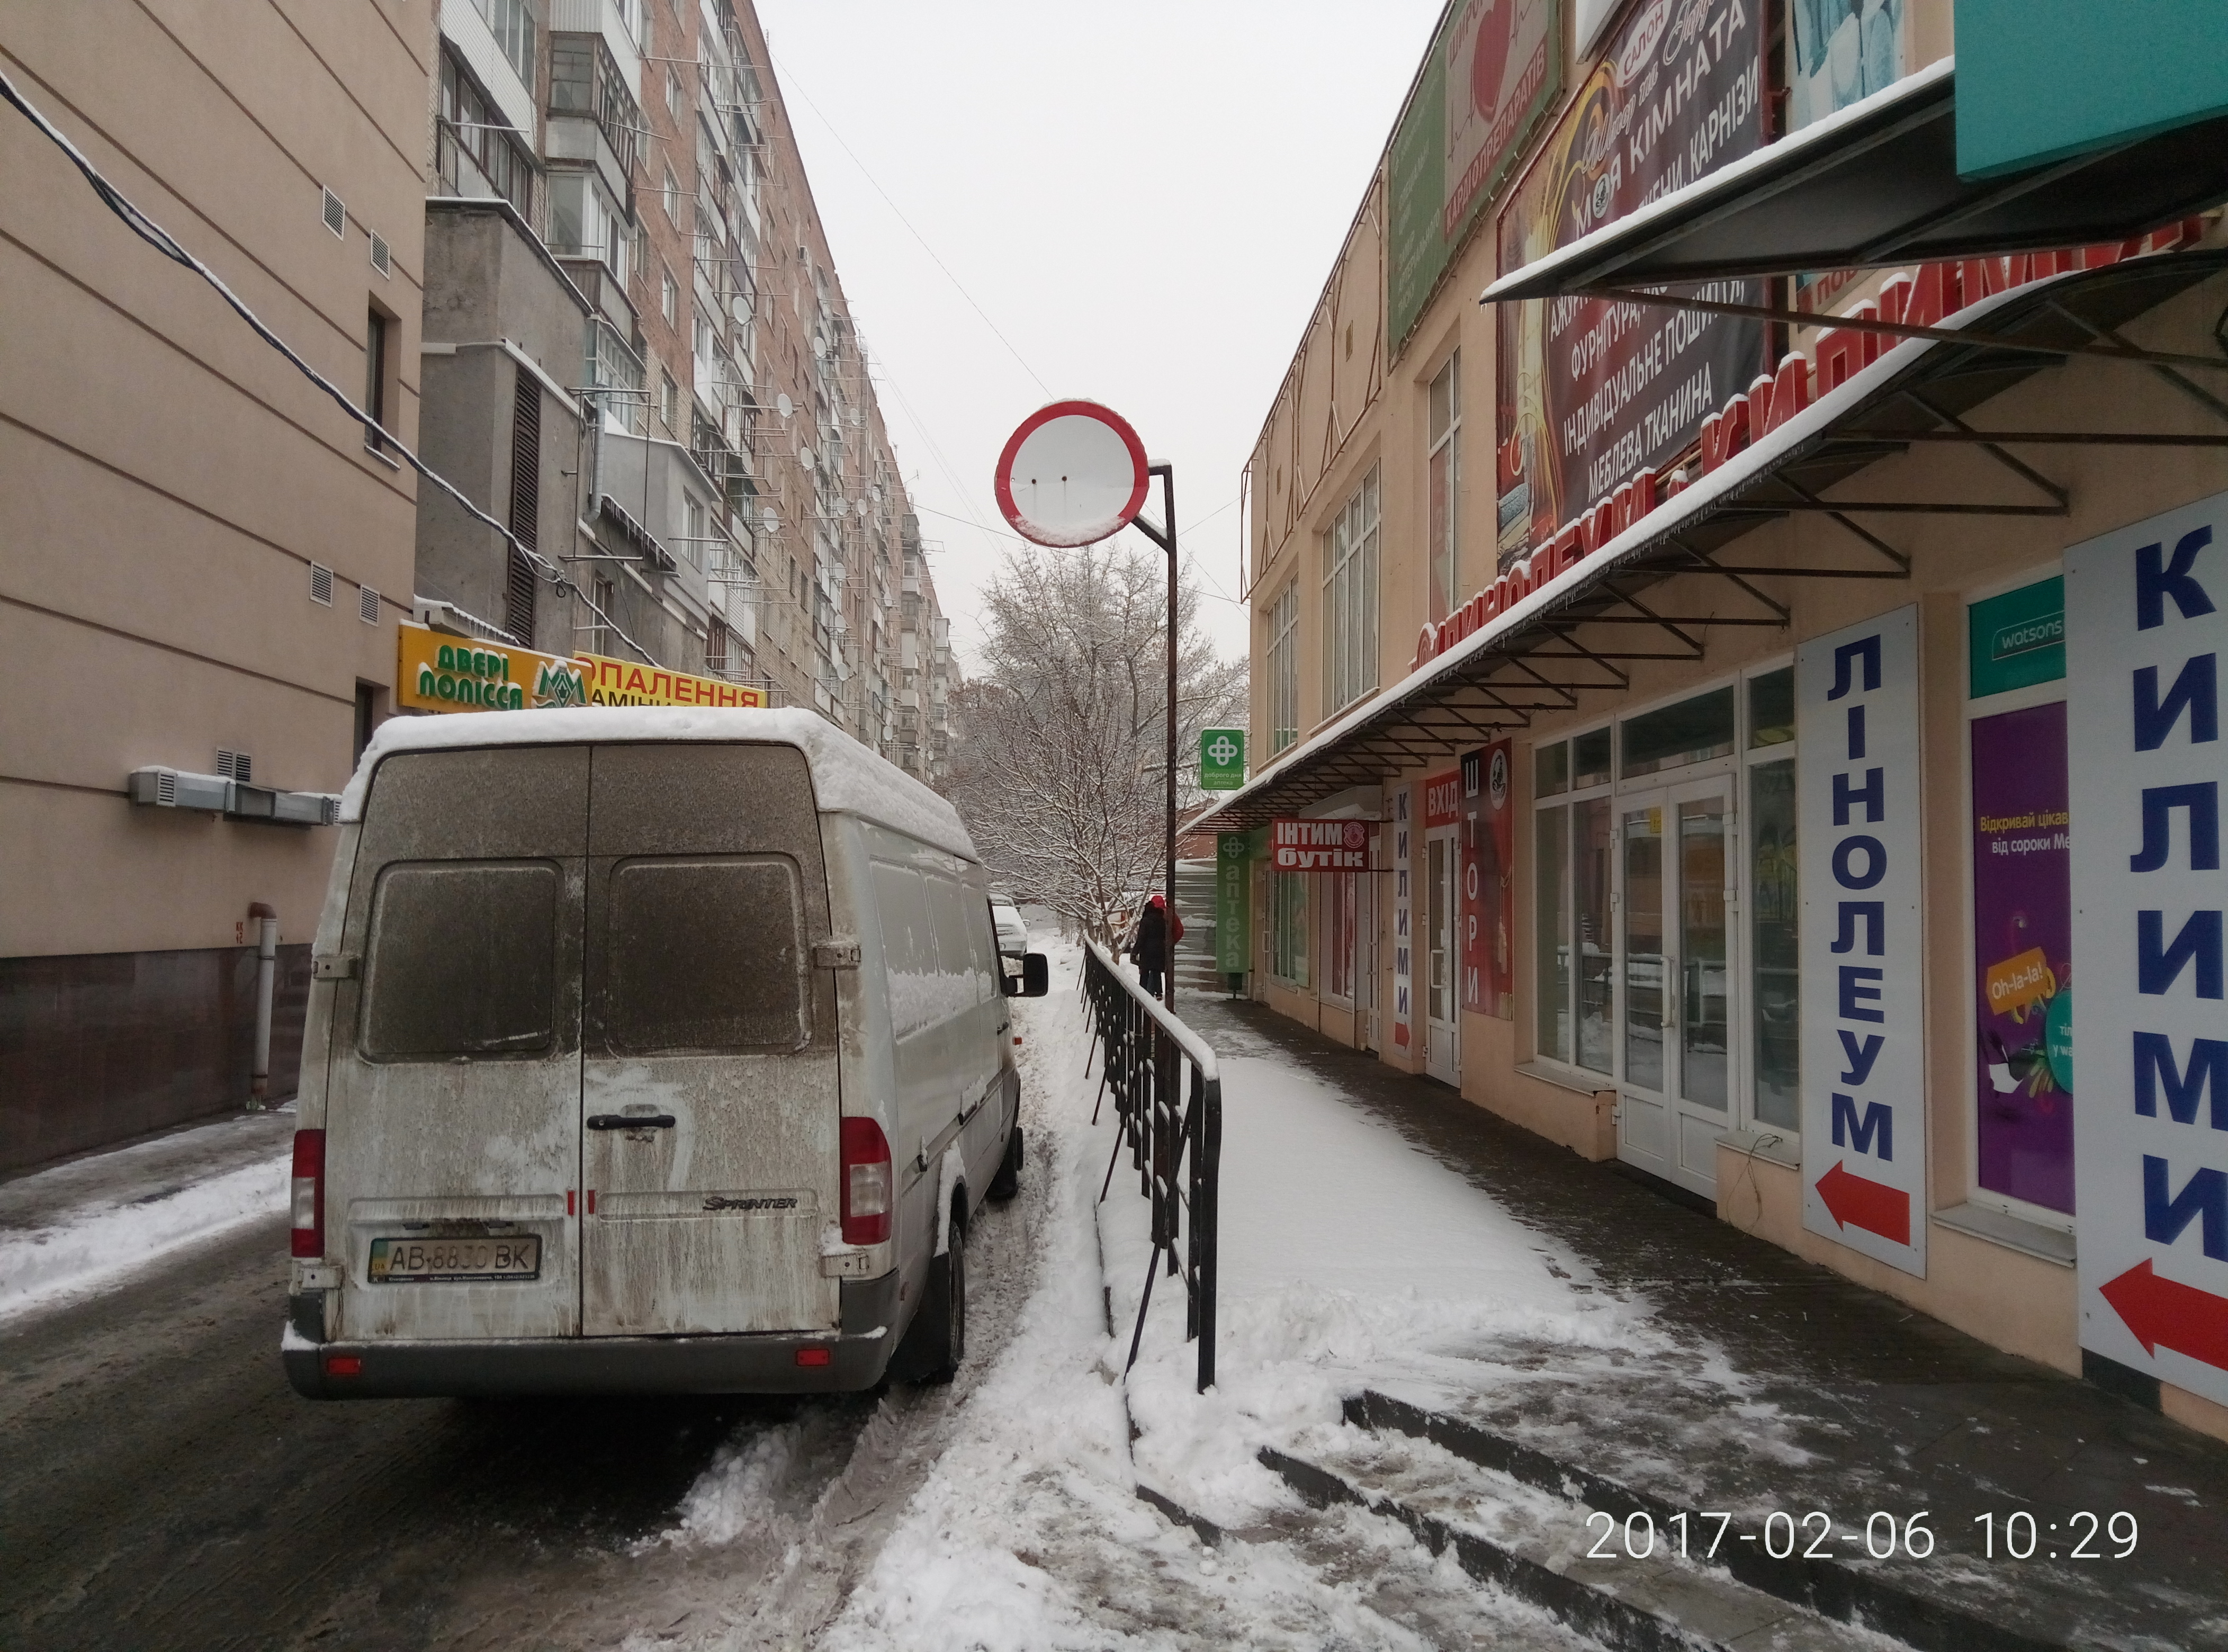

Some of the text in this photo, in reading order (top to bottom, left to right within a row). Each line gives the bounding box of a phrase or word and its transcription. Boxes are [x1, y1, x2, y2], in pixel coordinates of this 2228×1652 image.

[1450, 0, 1483, 69] ШИРО
[1624, 3, 1664, 75] САЛОН
[1630, 0, 1746, 174] КІМНАТА
[1690, 55, 1758, 182] КАРНІЗИ
[1447, 44, 1544, 234] КАРДІОПРЕПАРАТІВ
[1571, 302, 1640, 381] ФУРНІТУРА,
[1565, 335, 1663, 456] ІНДИВІДУАЛЬНЕ
[1588, 362, 1712, 502] МЕБЛЕВА ТКАНИНА
[436, 645, 509, 681] ДВЕРІ
[2002, 620, 2063, 649] watsons
[419, 669, 523, 710] ПОЛІССЯ
[1277, 822, 1343, 846] ІНТИМ
[1428, 780, 1459, 819] ВХІД
[1980, 809, 2069, 834] Відкривай цікав
[1278, 848, 1364, 868] бутік
[1466, 759, 1478, 1004] ШТОРИ
[1992, 837, 2009, 856] від
[2011, 837, 2051, 856] сороки
[1225, 865, 1241, 968] аптека
[1398, 791, 1408, 1015] КИЛИМИ
[1828, 634, 1892, 1162] ЛІНОЛЕУМ
[2131, 524, 2228, 1263] КИЛИМИ
[1992, 961, 2044, 1000] Oh-la-la!
